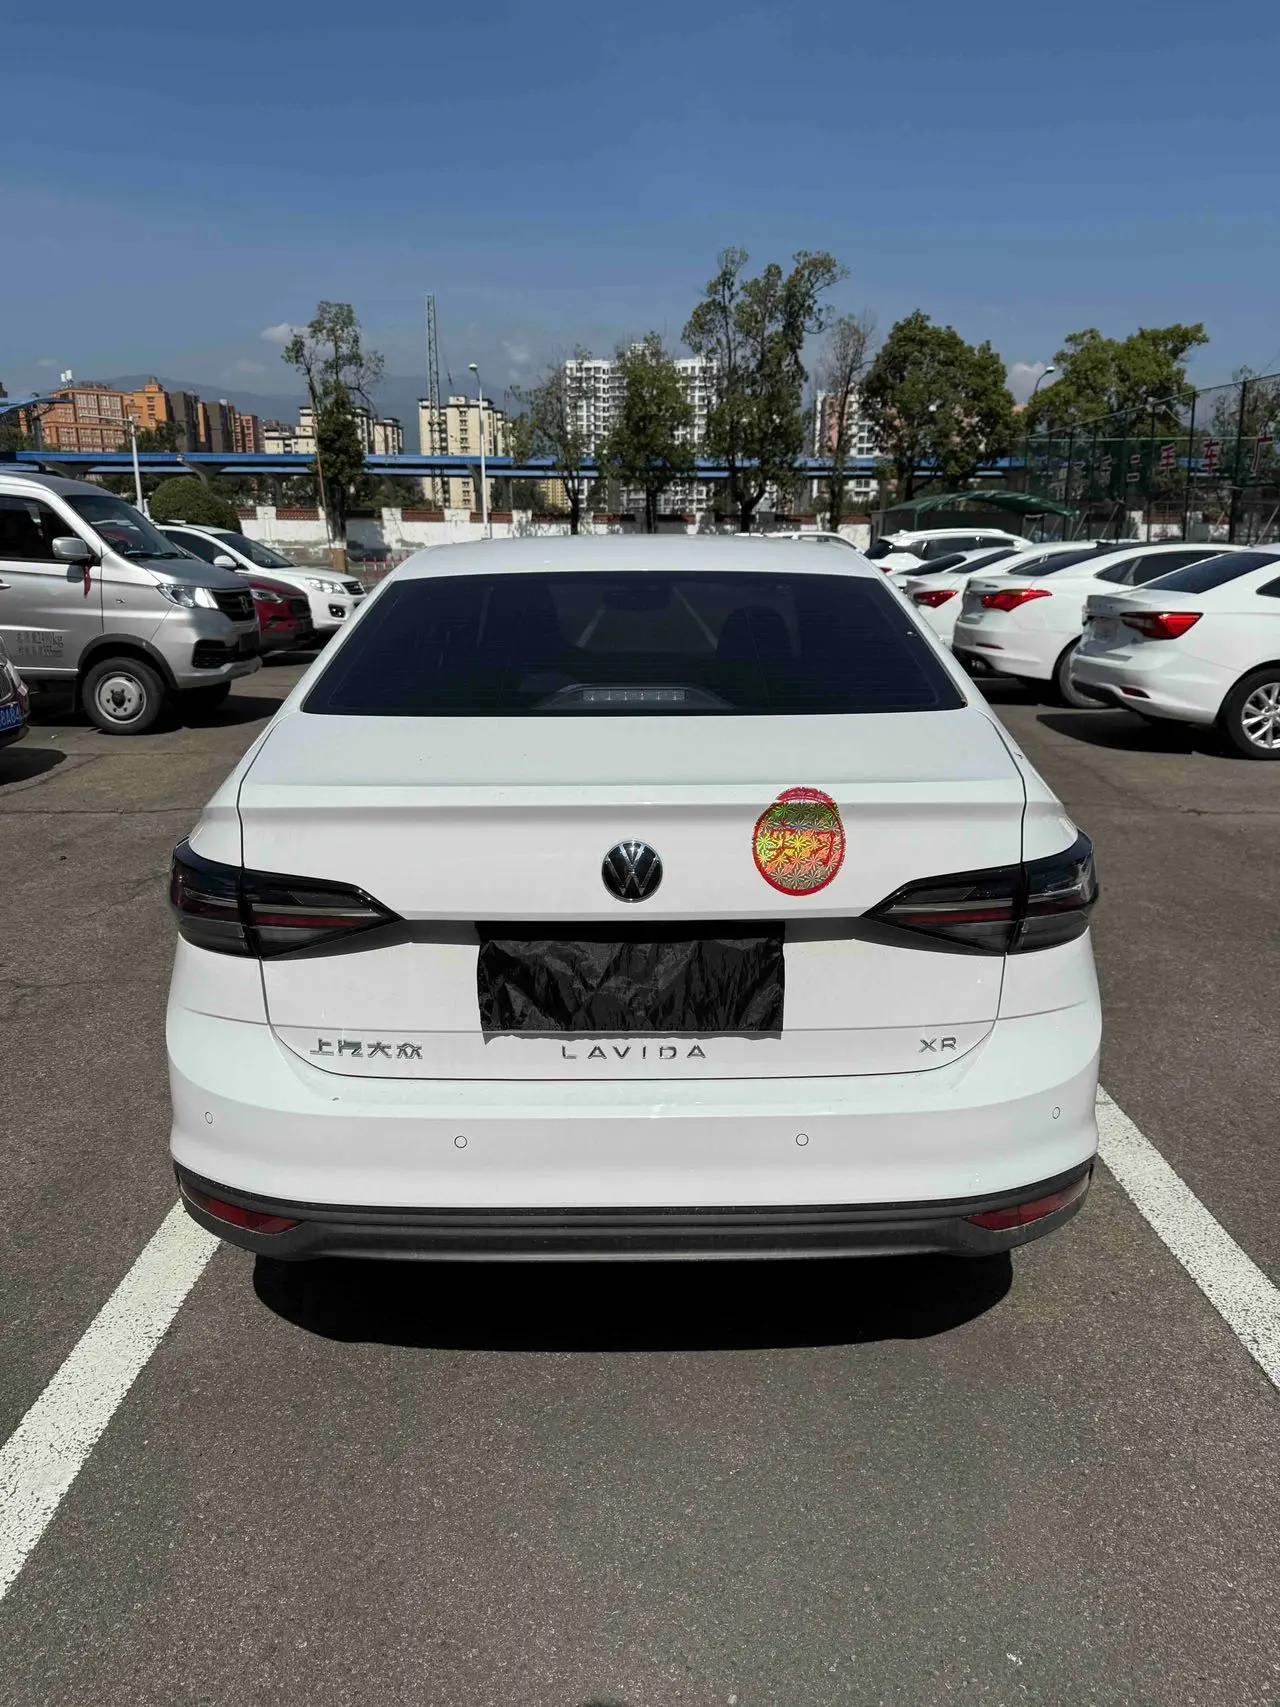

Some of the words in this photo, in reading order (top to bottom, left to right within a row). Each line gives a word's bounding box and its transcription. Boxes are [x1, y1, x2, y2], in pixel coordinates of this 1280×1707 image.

[310, 1038, 423, 1059] 上汽大众
[561, 1045, 706, 1059] LAVIDA
[919, 1037, 957, 1053] XR
